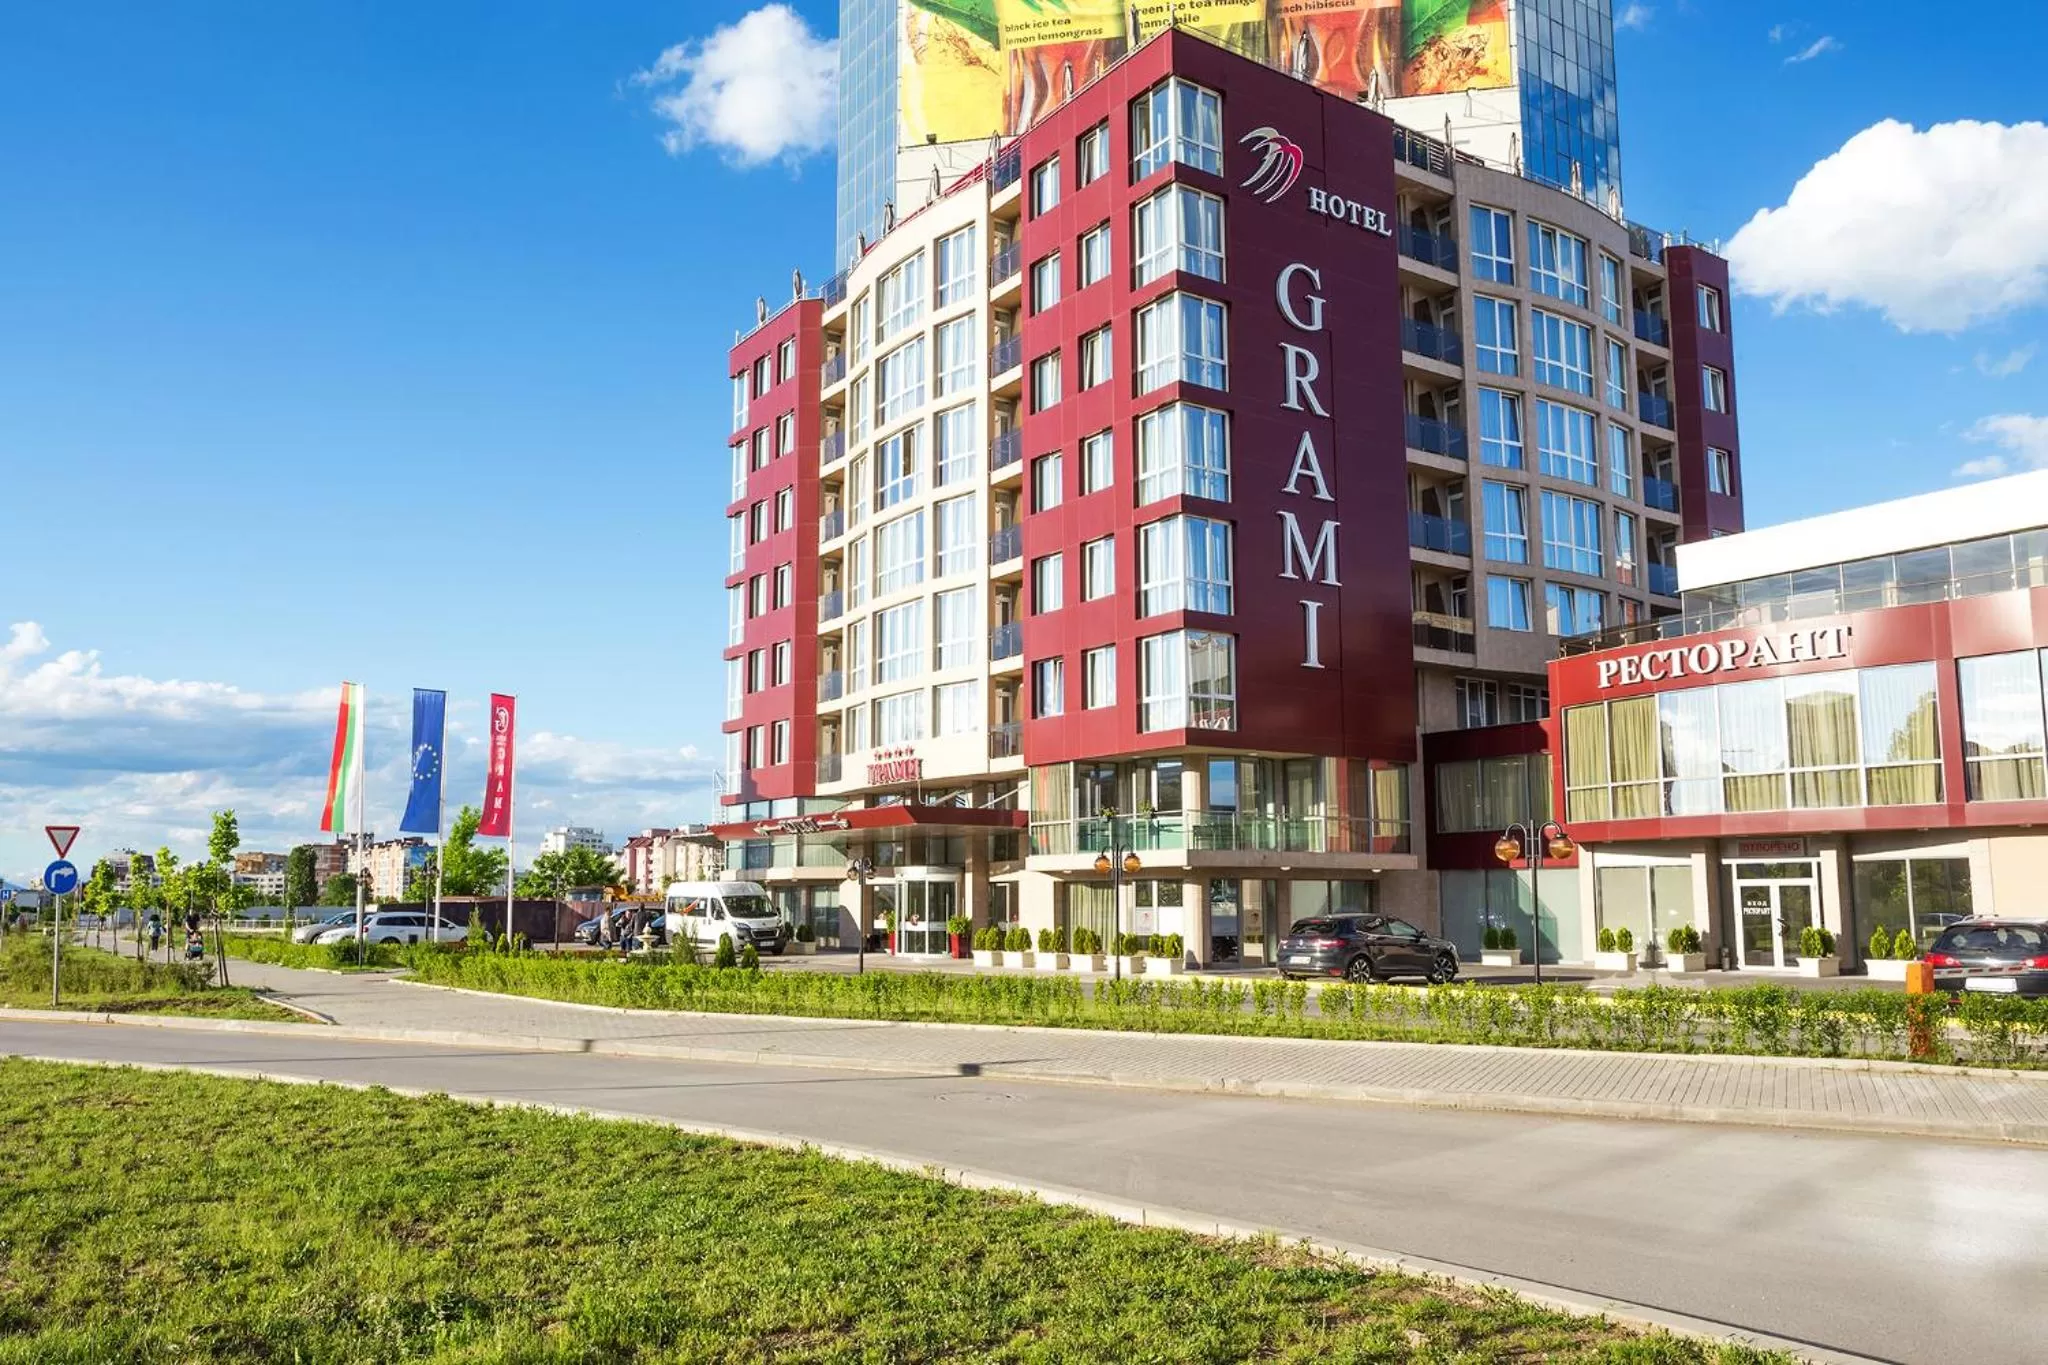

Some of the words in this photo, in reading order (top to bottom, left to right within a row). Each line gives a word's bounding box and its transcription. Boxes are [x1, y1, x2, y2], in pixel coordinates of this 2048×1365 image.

[1136, 5, 1164, 15] reen
[1189, 0, 1213, 9] tea
[1277, 3, 1303, 13] each
[1304, 0, 1356, 11] hibiscus
[1004, 21, 1031, 33] black
[1032, 19, 1050, 29] ice
[1051, 17, 1072, 27] tea
[1139, 13, 1201, 29] amoile
[1005, 35, 1036, 45] lemon
[1037, 26, 1104, 41] lemongrass
[1307, 186, 1392, 238] HOTEL
[1275, 262, 1343, 669] GRAMI
[1597, 626, 1853, 689] РЕСТОРАНТ
